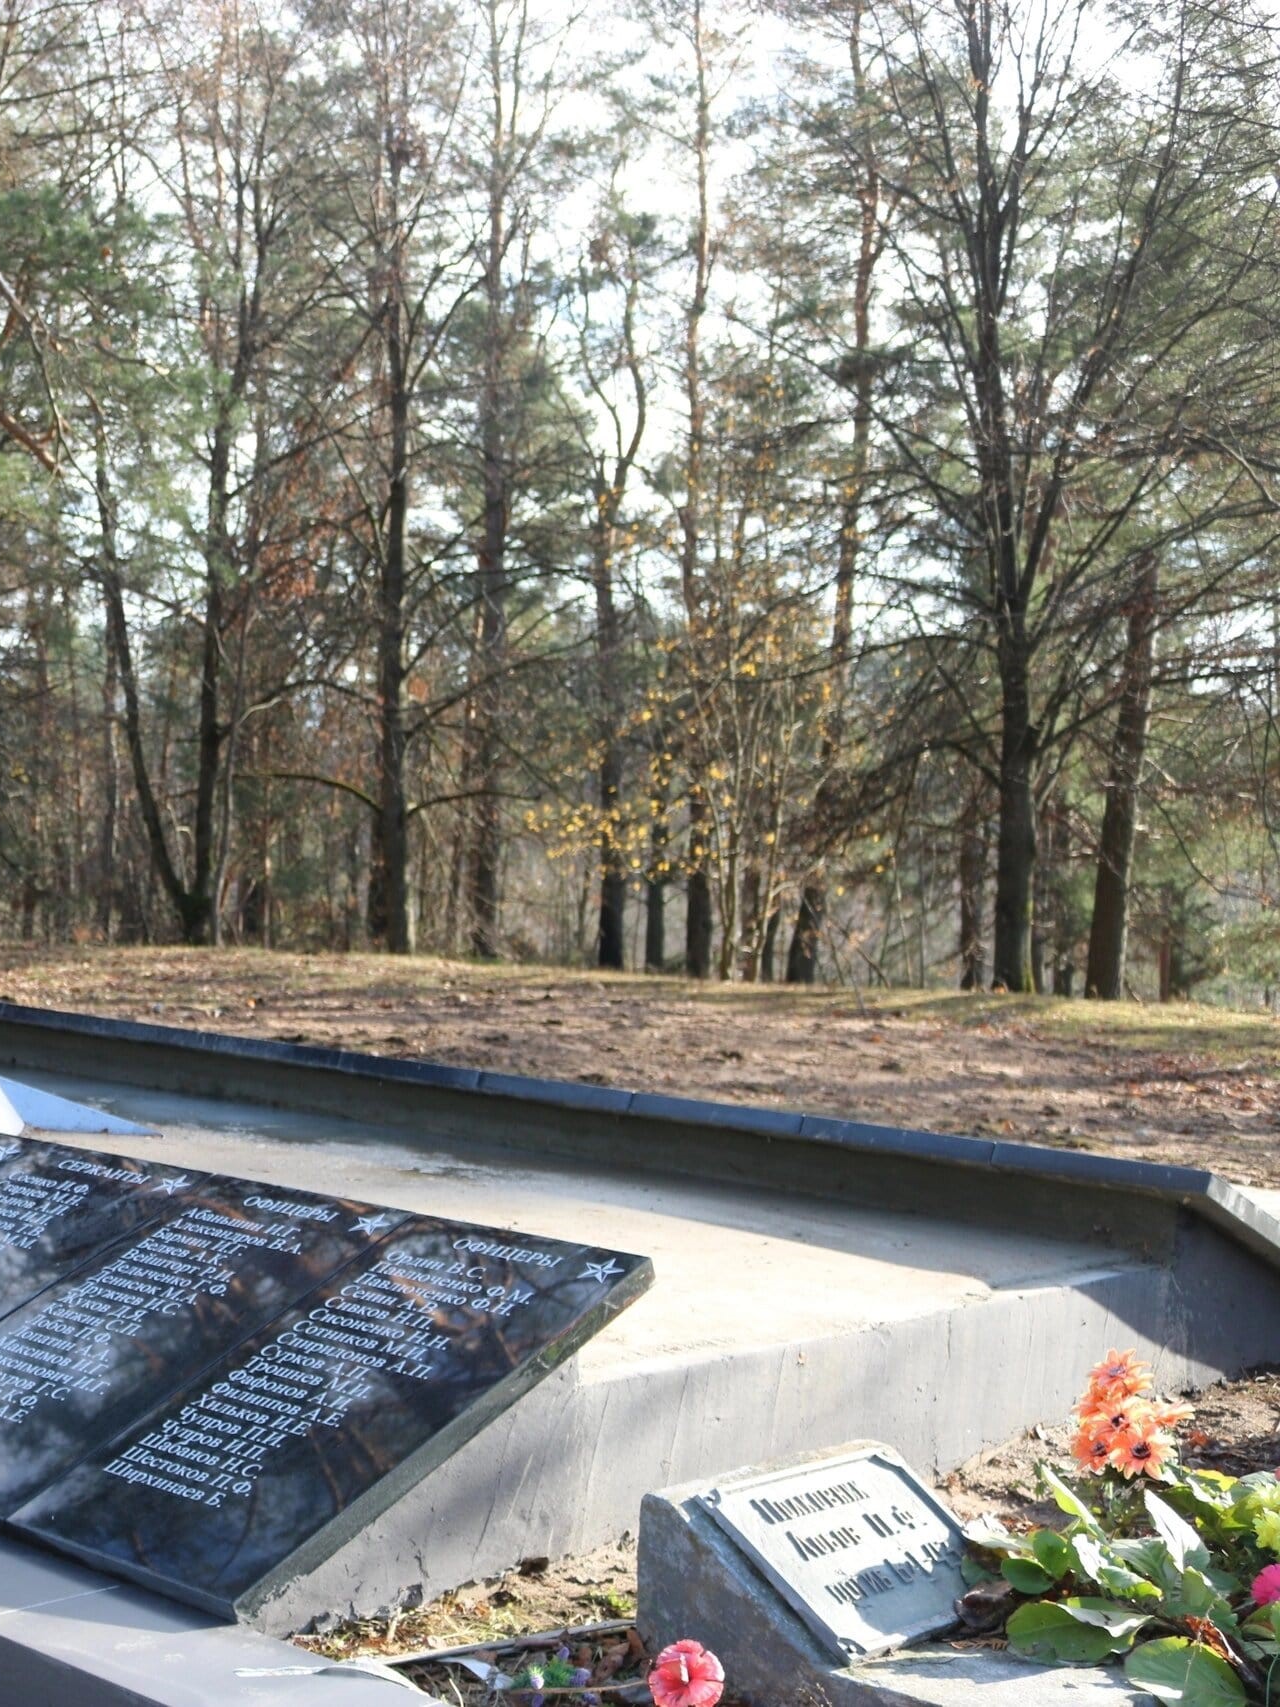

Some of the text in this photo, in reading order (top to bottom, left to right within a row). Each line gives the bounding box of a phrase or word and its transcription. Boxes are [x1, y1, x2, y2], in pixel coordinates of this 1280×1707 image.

[57, 1159, 153, 1184] СЕРЖАНТЫ
[180, 1206, 266, 1232] Абаньшин
[242, 1195, 340, 1223] ОФИЦЕРЫ
[135, 1236, 190, 1257] Беляев
[150, 1226, 213, 1248] Бармин
[165, 1216, 267, 1246] Александров
[386, 1249, 487, 1279] Ордин В.С.
[452, 1238, 564, 1268] ОФИЦЕРЫ
[84, 1268, 162, 1295] Денисюк
[352, 1271, 516, 1316] Павлюченко Ф.Н.
[367, 1260, 535, 1305] Павлюченко Ф.М.
[56, 1290, 111, 1312] Жуков
[324, 1296, 436, 1330] Сивков Н.П.
[340, 1284, 438, 1315] Сенин А.В.
[8, 1324, 78, 1351] Лопатин
[24, 1313, 75, 1334] Лобов
[293, 1319, 429, 1362] Сотников М.И.
[308, 1307, 452, 1350] Сисоненко Н.Н.
[260, 1343, 371, 1381] Сурков А.П.
[277, 1331, 434, 1380] Спиридонов А.П.
[243, 1354, 373, 1399] Трошнев М.И.
[189, 1392, 312, 1437] Хильков И.Е.
[211, 1380, 344, 1428] Филиппов А.Е.
[305, 1391, 354, 1412] А.И.
[161, 1418, 267, 1462] Чупров И.П.
[178, 1404, 287, 1448] Чупров П.И.
[119, 1444, 251, 1498] Шестоков П.Ф.
[138, 1430, 263, 1480] Шабанов Н.С.
[102, 1457, 226, 1508] Ширхинаев Б.
